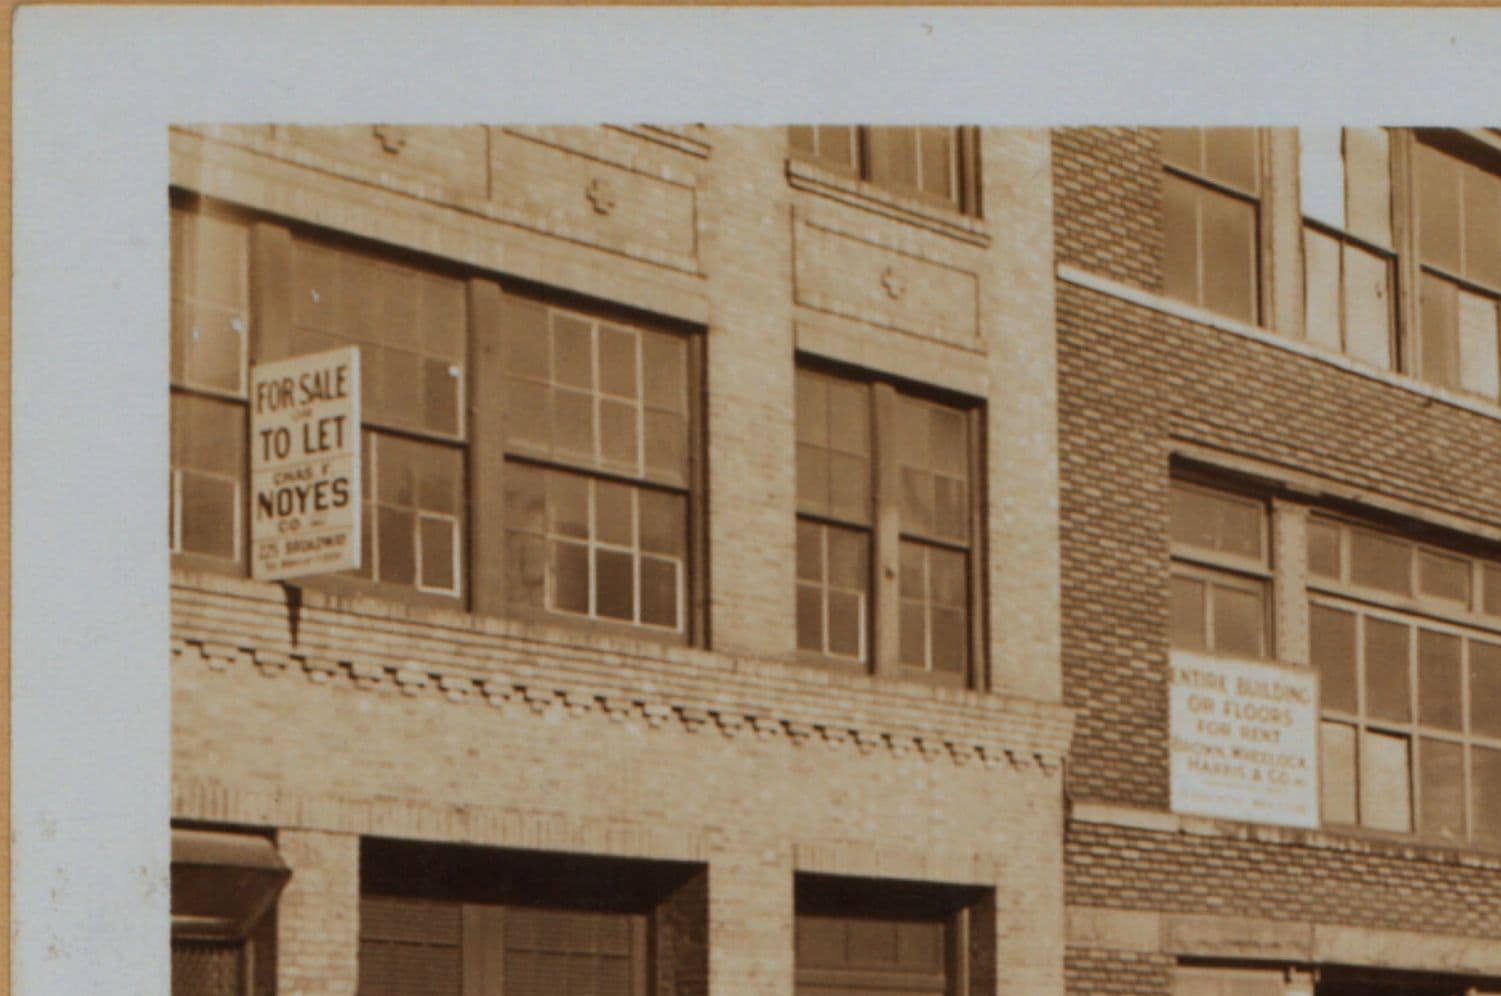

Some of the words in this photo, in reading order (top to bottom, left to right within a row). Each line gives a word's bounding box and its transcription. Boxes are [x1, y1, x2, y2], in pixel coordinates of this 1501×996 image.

[257, 377, 294, 415] FOR
[299, 365, 347, 405] SALE
[260, 426, 291, 462] TO
[303, 414, 346, 454] LET
[257, 477, 349, 520] NOYES
[1237, 675, 1312, 705] BUILDING
[1187, 694, 1215, 714] OR
[1223, 700, 1294, 727] FLOORS
[1196, 719, 1232, 737] FOR
[1240, 725, 1281, 744] RENT
